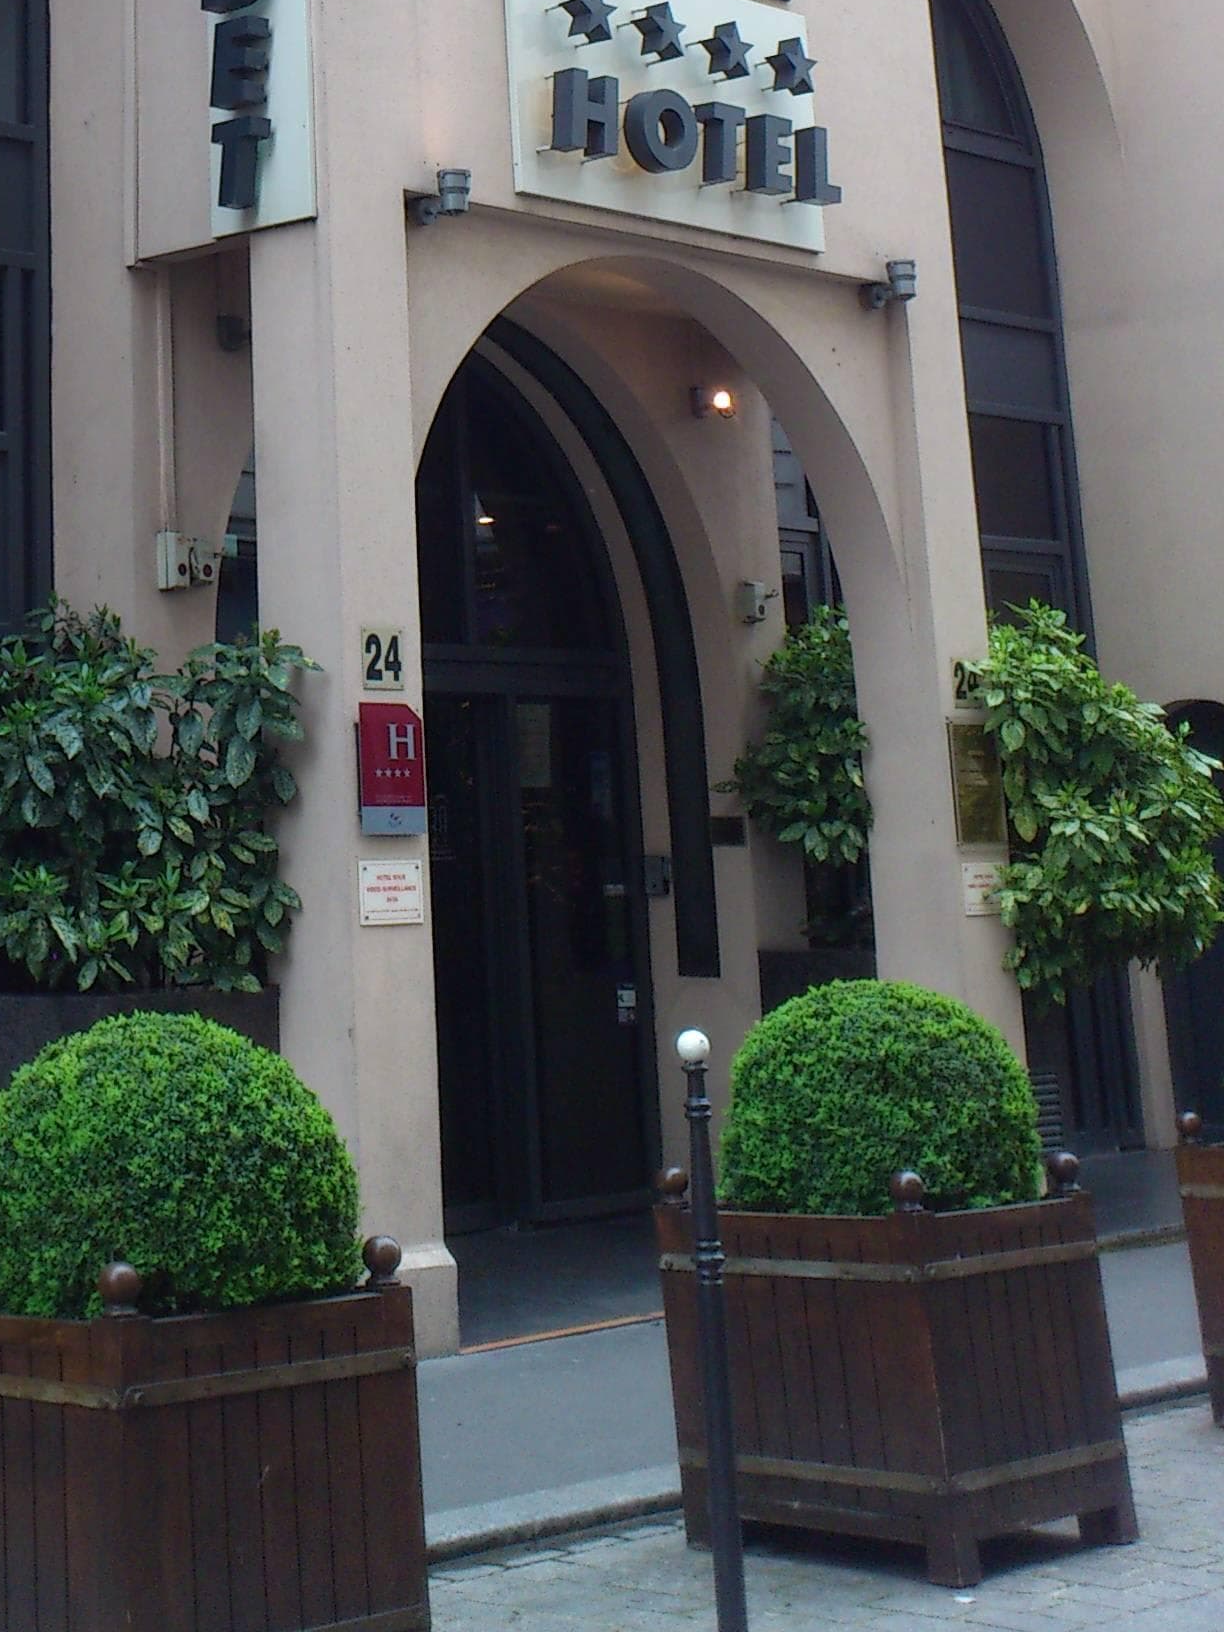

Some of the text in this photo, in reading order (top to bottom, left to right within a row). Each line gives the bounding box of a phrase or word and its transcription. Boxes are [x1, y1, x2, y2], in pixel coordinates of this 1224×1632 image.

[550, 67, 843, 207] HOTEL
[364, 633, 402, 683] 24
[387, 722, 417, 761] H
